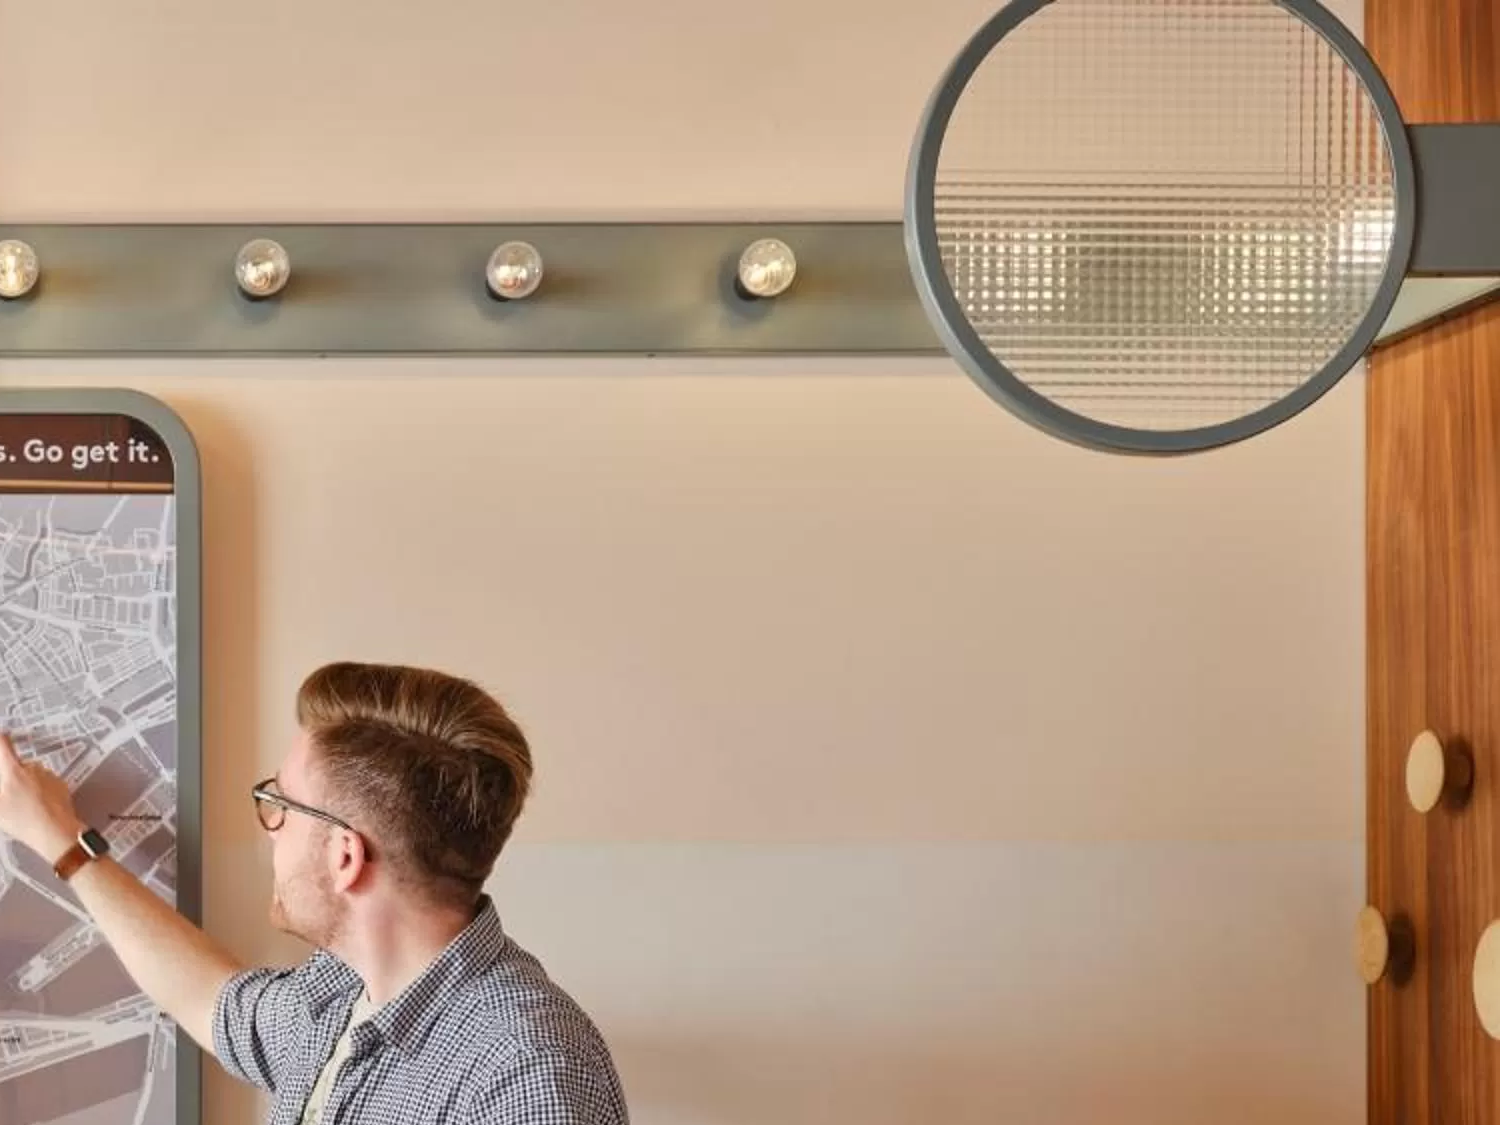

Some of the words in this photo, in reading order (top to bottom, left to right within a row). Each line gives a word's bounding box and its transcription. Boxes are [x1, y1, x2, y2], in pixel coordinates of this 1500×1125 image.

[23, 438, 64, 462] Go
[71, 440, 119, 470] get
[128, 438, 160, 463] it.
